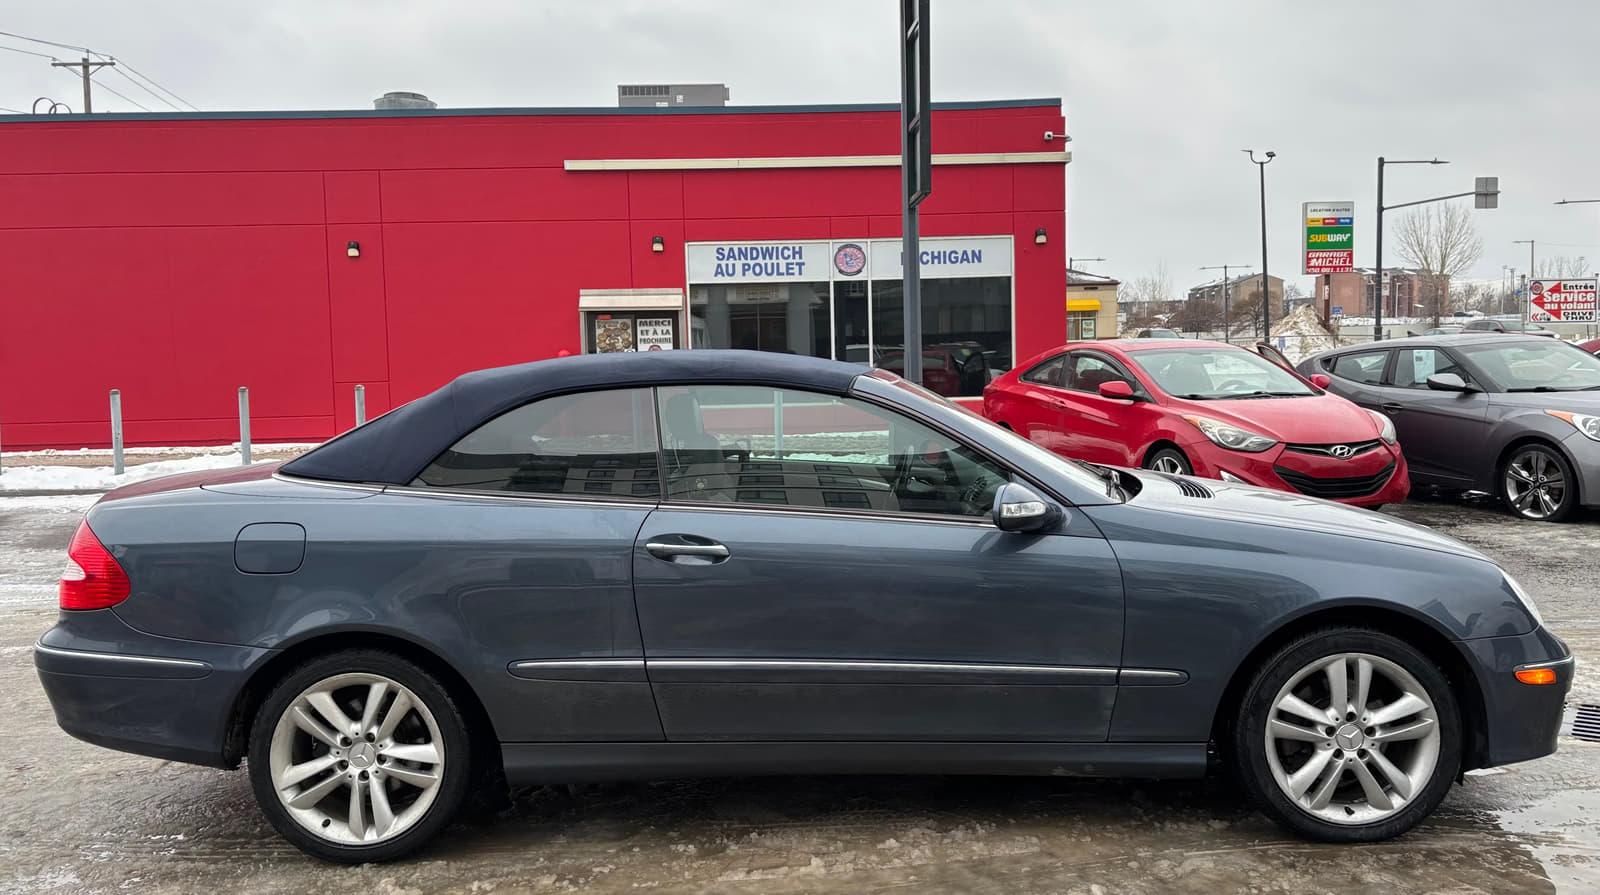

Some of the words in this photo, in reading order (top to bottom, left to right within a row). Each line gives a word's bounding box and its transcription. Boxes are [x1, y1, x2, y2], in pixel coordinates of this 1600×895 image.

[1309, 233, 1350, 242] SUBWAY
[715, 246, 803, 261] SANDWICH
[901, 249, 982, 265] CHIGAN
[1310, 257, 1352, 266] MICHEL
[714, 262, 735, 277] AU
[742, 261, 805, 276] POULET
[1543, 291, 1595, 302] Service
[1560, 302, 1595, 310] volant
[652, 328, 659, 336] À
